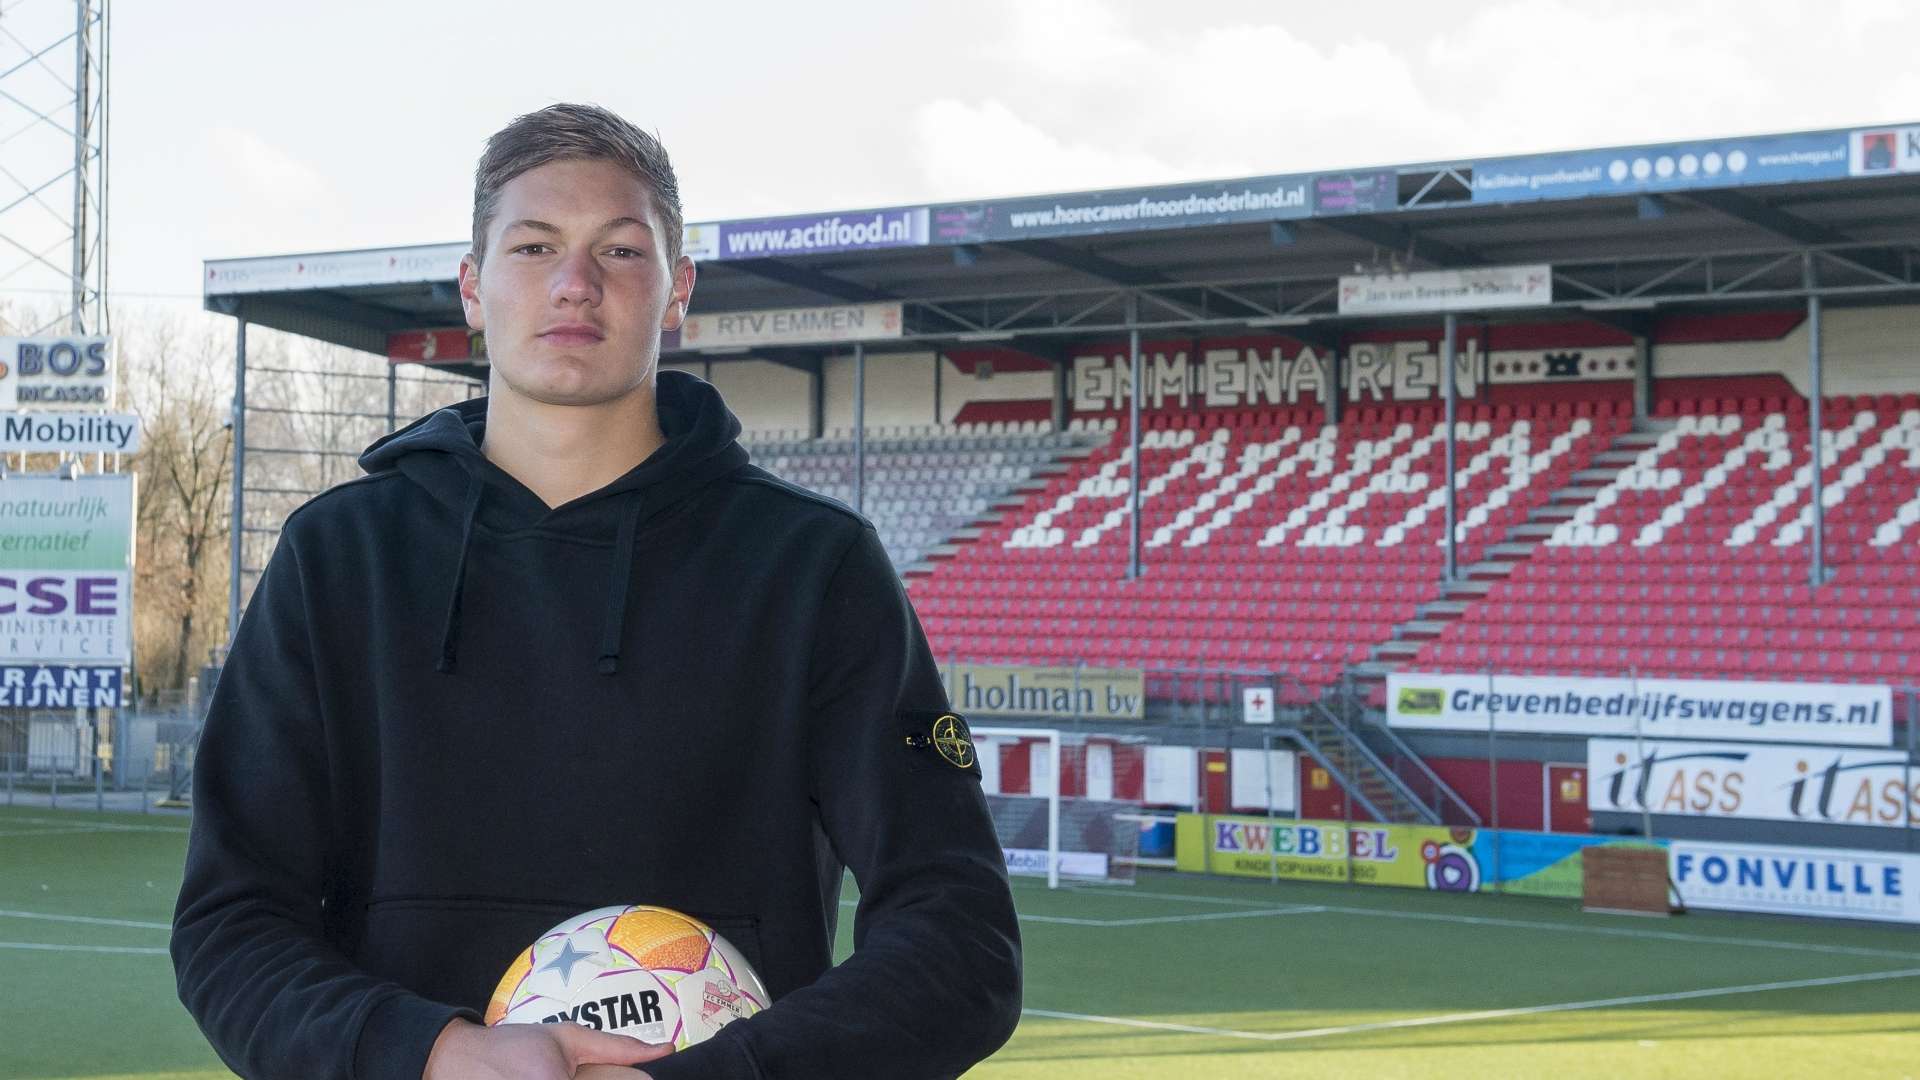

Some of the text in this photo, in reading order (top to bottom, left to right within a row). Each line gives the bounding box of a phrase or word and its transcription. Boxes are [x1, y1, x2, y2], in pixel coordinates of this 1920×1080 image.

[727, 211, 911, 254] www.actifood.nl
[717, 308, 864, 335] RTV EMMEN
[18, 342, 105, 377] BOS
[5, 417, 133, 448] Mobility
[0, 497, 108, 521] natuurlijk
[0, 619, 113, 635] INISTRATIE
[963, 674, 1094, 711] holman
[1106, 685, 1138, 714] bv
[1452, 688, 1881, 726] Grevenbedrijfswagens.nl
[1215, 821, 1397, 861] KWEBBEL
[1677, 854, 1903, 896] FONVILLE
